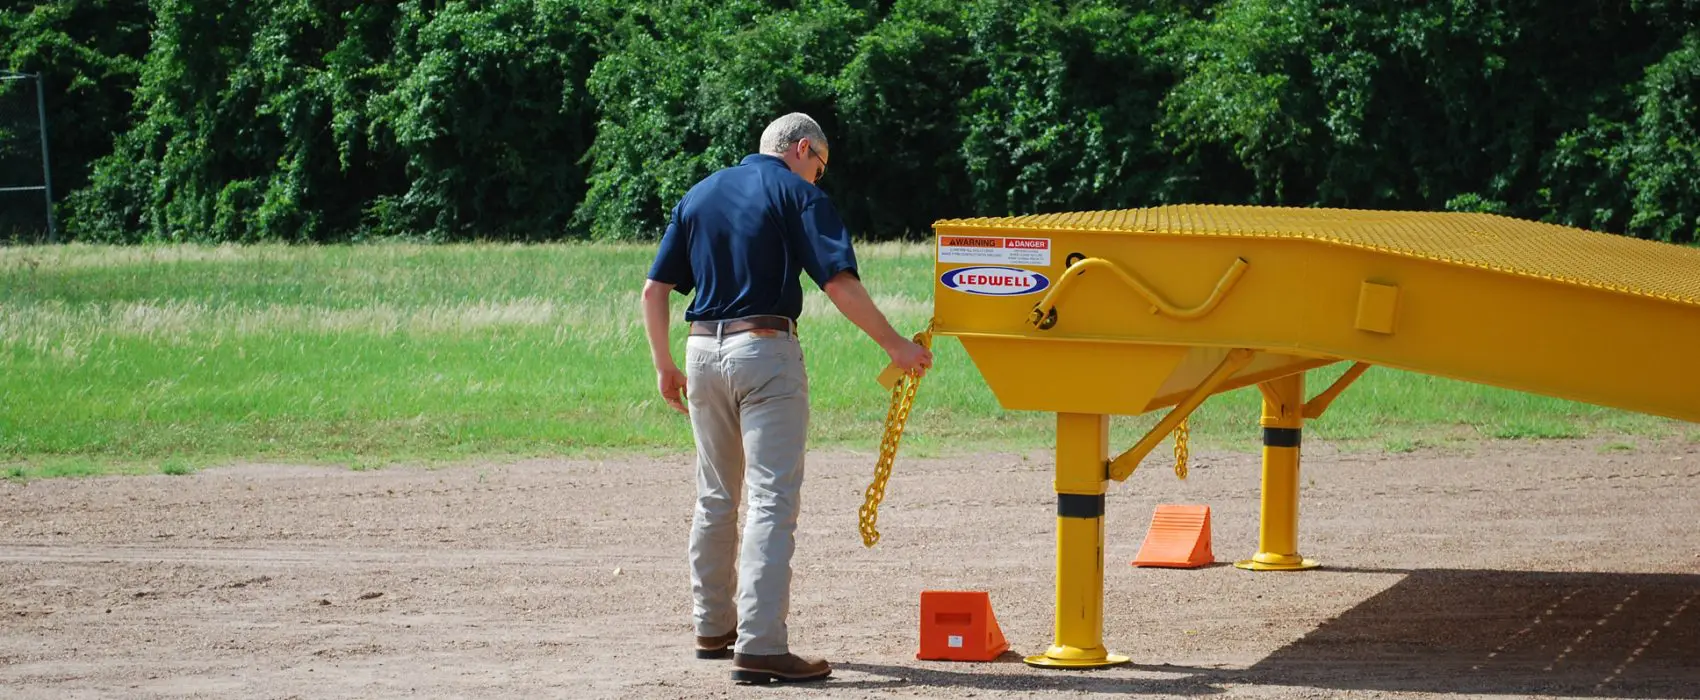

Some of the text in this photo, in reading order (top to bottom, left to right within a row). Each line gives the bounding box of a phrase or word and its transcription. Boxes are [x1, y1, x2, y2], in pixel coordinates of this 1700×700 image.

[955, 238, 996, 247] WARNING
[1014, 240, 1045, 248] DANGER
[959, 274, 1031, 287] LEDWELL
